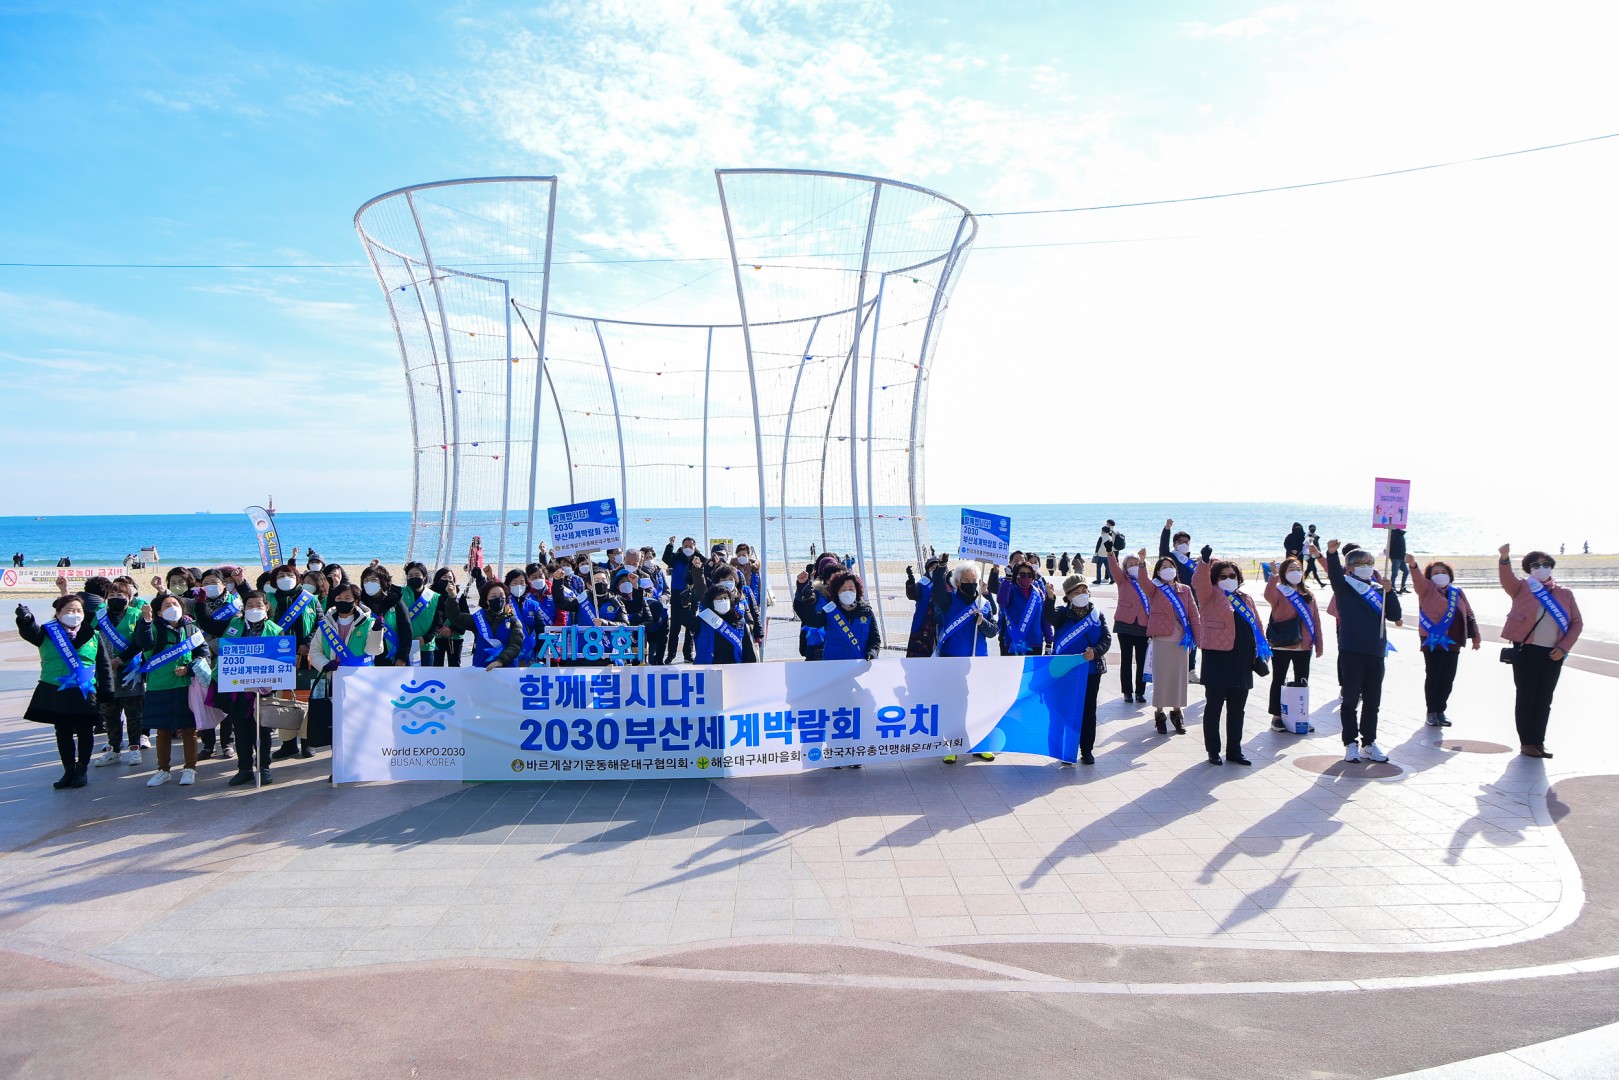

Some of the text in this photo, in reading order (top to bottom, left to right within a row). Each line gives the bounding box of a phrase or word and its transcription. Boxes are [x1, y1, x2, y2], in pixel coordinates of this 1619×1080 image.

[554, 522, 574, 532] 2030
[554, 525, 616, 542] 부산세계박람회 유치
[964, 526, 978, 536] 2030
[963, 536, 1008, 551] 부산세계박람회 유치
[537, 624, 645, 662] 제8회
[222, 664, 292, 675] 부산세계박람회 유치
[520, 672, 705, 710] 함께뜁시다!
[876, 704, 939, 739] 유치
[382, 747, 465, 756] World EXPO 2030
[390, 758, 455, 767] BUSAN, KOREA
